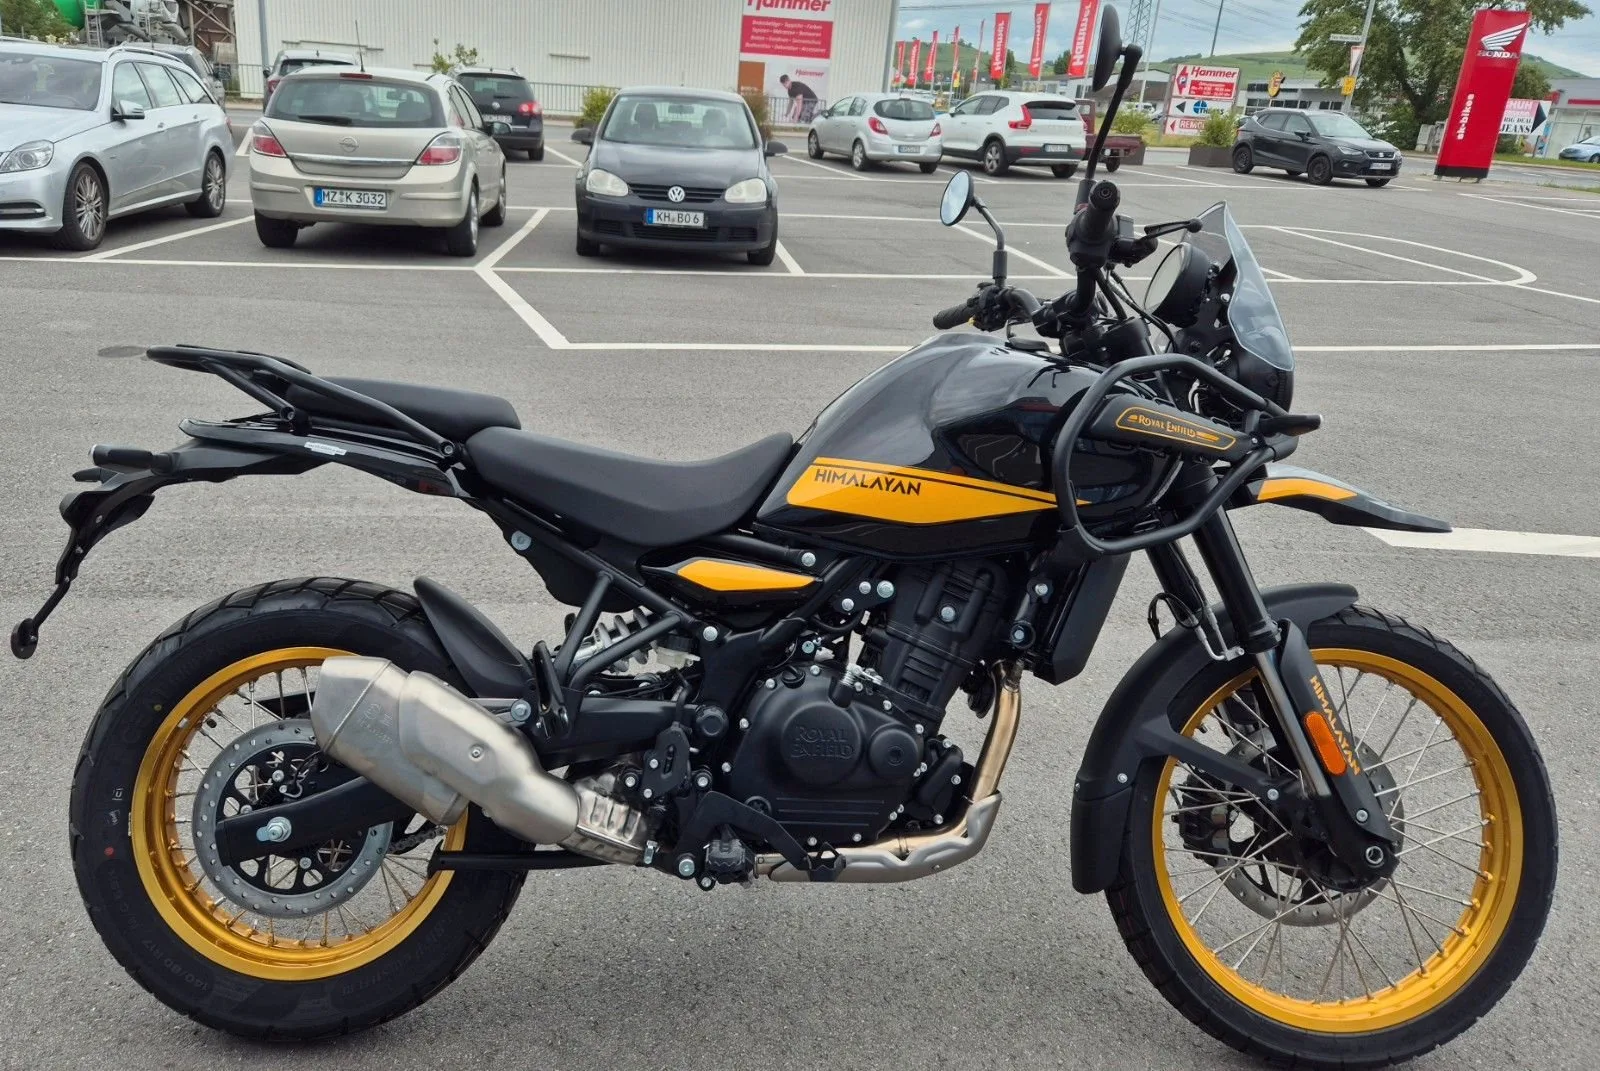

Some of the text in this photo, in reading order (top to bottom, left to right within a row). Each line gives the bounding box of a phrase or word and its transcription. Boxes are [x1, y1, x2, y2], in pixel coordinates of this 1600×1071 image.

[1476, 50, 1520, 58] HONDA
[1191, 66, 1237, 78] Hammer
[1500, 123, 1531, 133] JEANS
[323, 190, 384, 205] MZ K 3032
[656, 211, 671, 222] KH
[693, 214, 700, 224] 6
[1138, 415, 1197, 438] ROYAL ENFIELD
[814, 468, 922, 496] HIMALAYAN
[1310, 675, 1361, 776] HIMALAYAN
[795, 726, 848, 743] ROYAL
[790, 743, 854, 759] ENFIELD
